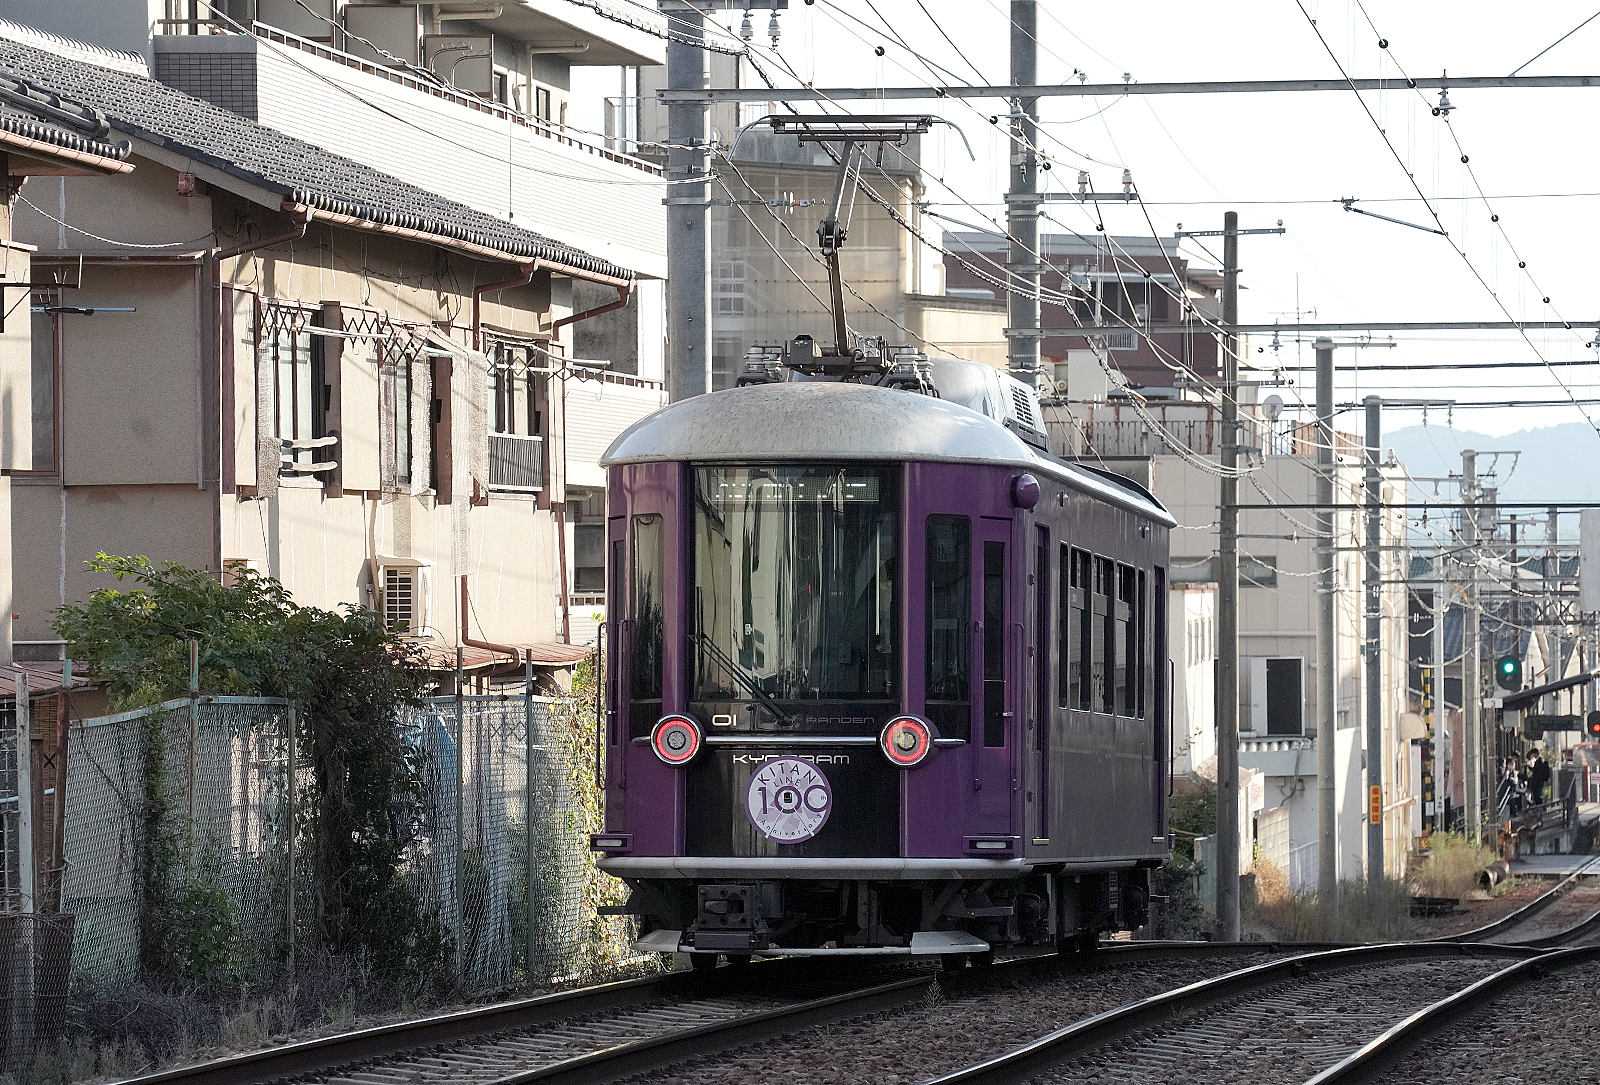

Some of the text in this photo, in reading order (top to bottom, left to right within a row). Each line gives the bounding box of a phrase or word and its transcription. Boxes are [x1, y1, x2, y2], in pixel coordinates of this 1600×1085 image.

[806, 716, 875, 724] RANDEN
[732, 754, 850, 765] KYRAM
[773, 776, 801, 788] LINE
[759, 812, 822, 836] Anniversary
